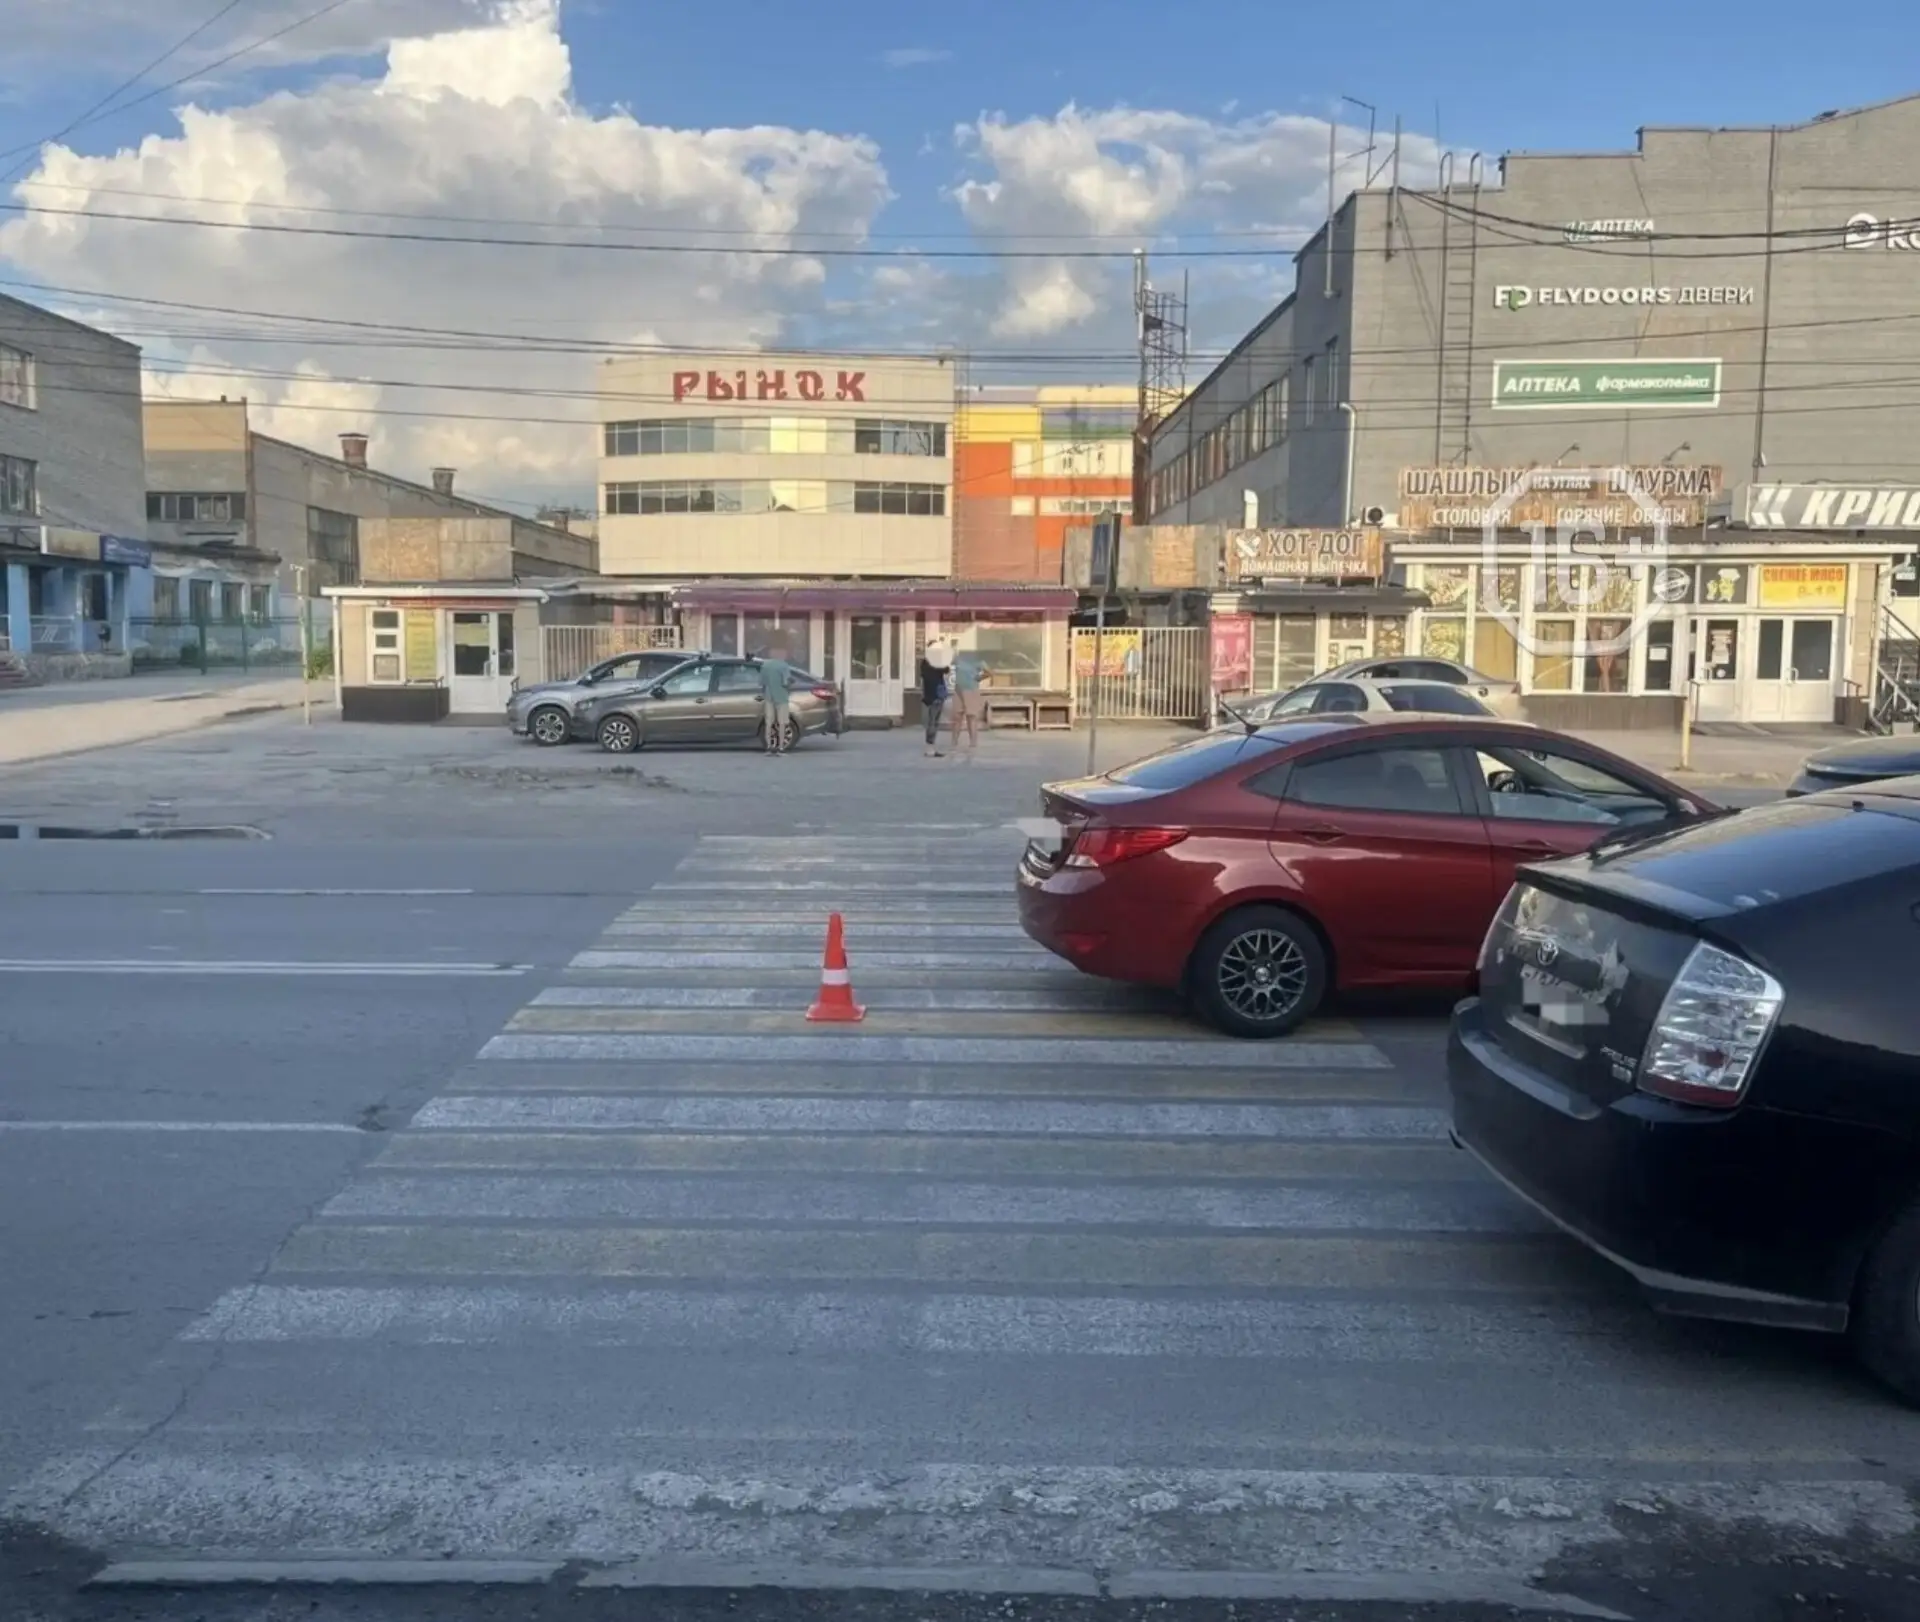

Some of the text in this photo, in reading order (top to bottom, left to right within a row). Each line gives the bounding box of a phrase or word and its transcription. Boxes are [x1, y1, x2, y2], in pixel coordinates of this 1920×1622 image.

[1538, 286, 1673, 305] FLYDOORS
[1677, 287, 1754, 305] ДВЕРИ
[673, 370, 866, 402] РЫНОК
[1504, 376, 1581, 393] АПТЕКА
[1406, 470, 1524, 495] ШАШЛЫК
[1607, 469, 1712, 494] ШАУРМА
[1432, 507, 1688, 526] СТОЛОВАЯ ГОРЯЧИЕ ОБЕДЫ
[1268, 532, 1364, 556] ХОТ-ДОГ
